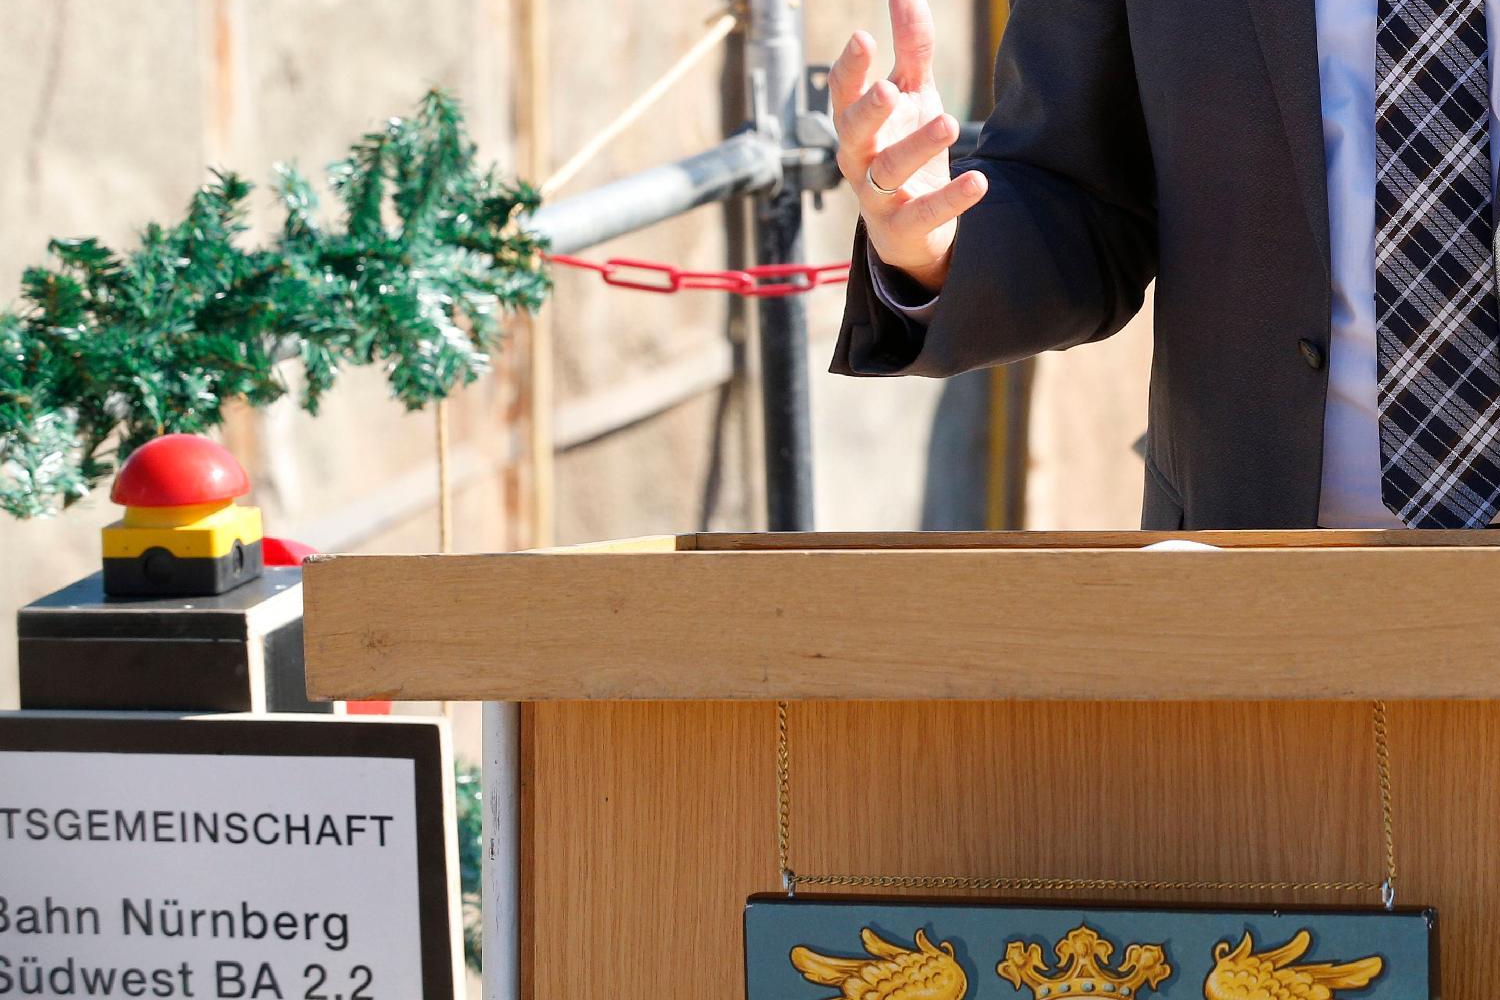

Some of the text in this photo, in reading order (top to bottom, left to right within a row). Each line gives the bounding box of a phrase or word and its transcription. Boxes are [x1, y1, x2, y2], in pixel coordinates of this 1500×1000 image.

[0, 807, 394, 847] TSGEMEINSCHAFT
[122, 897, 349, 952] Nürnberg
[215, 960, 283, 999] BA
